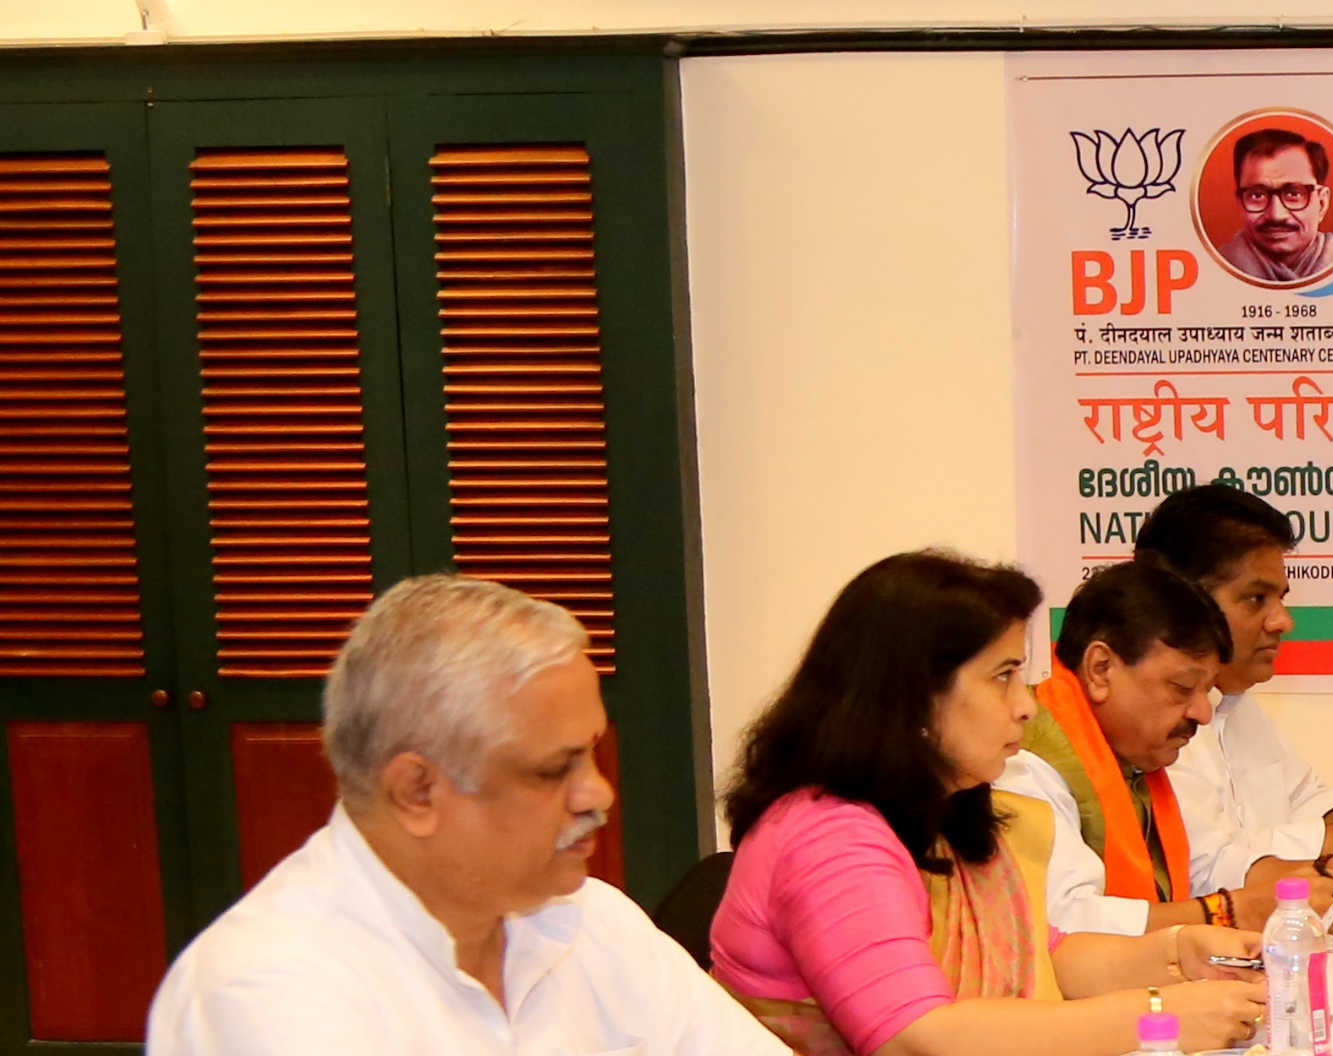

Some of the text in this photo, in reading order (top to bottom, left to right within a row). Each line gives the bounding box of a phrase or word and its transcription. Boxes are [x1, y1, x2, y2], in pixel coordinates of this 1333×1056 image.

[1071, 249, 1199, 316] BJP
[1241, 305, 1273, 319] 1916
[1284, 304, 1318, 318] 1968
[1099, 323, 1172, 344] दीनदयाल
[1177, 326, 1245, 343] उपाध्याय
[1250, 326, 1285, 342] जन्म
[1073, 351, 1092, 365] PT.
[1094, 350, 1167, 365] DEENDAYAL
[1168, 349, 1240, 364] UPADHYAYA
[1243, 347, 1315, 363] CENTENARY
[1077, 379, 1230, 457] राष्ट्रीय
